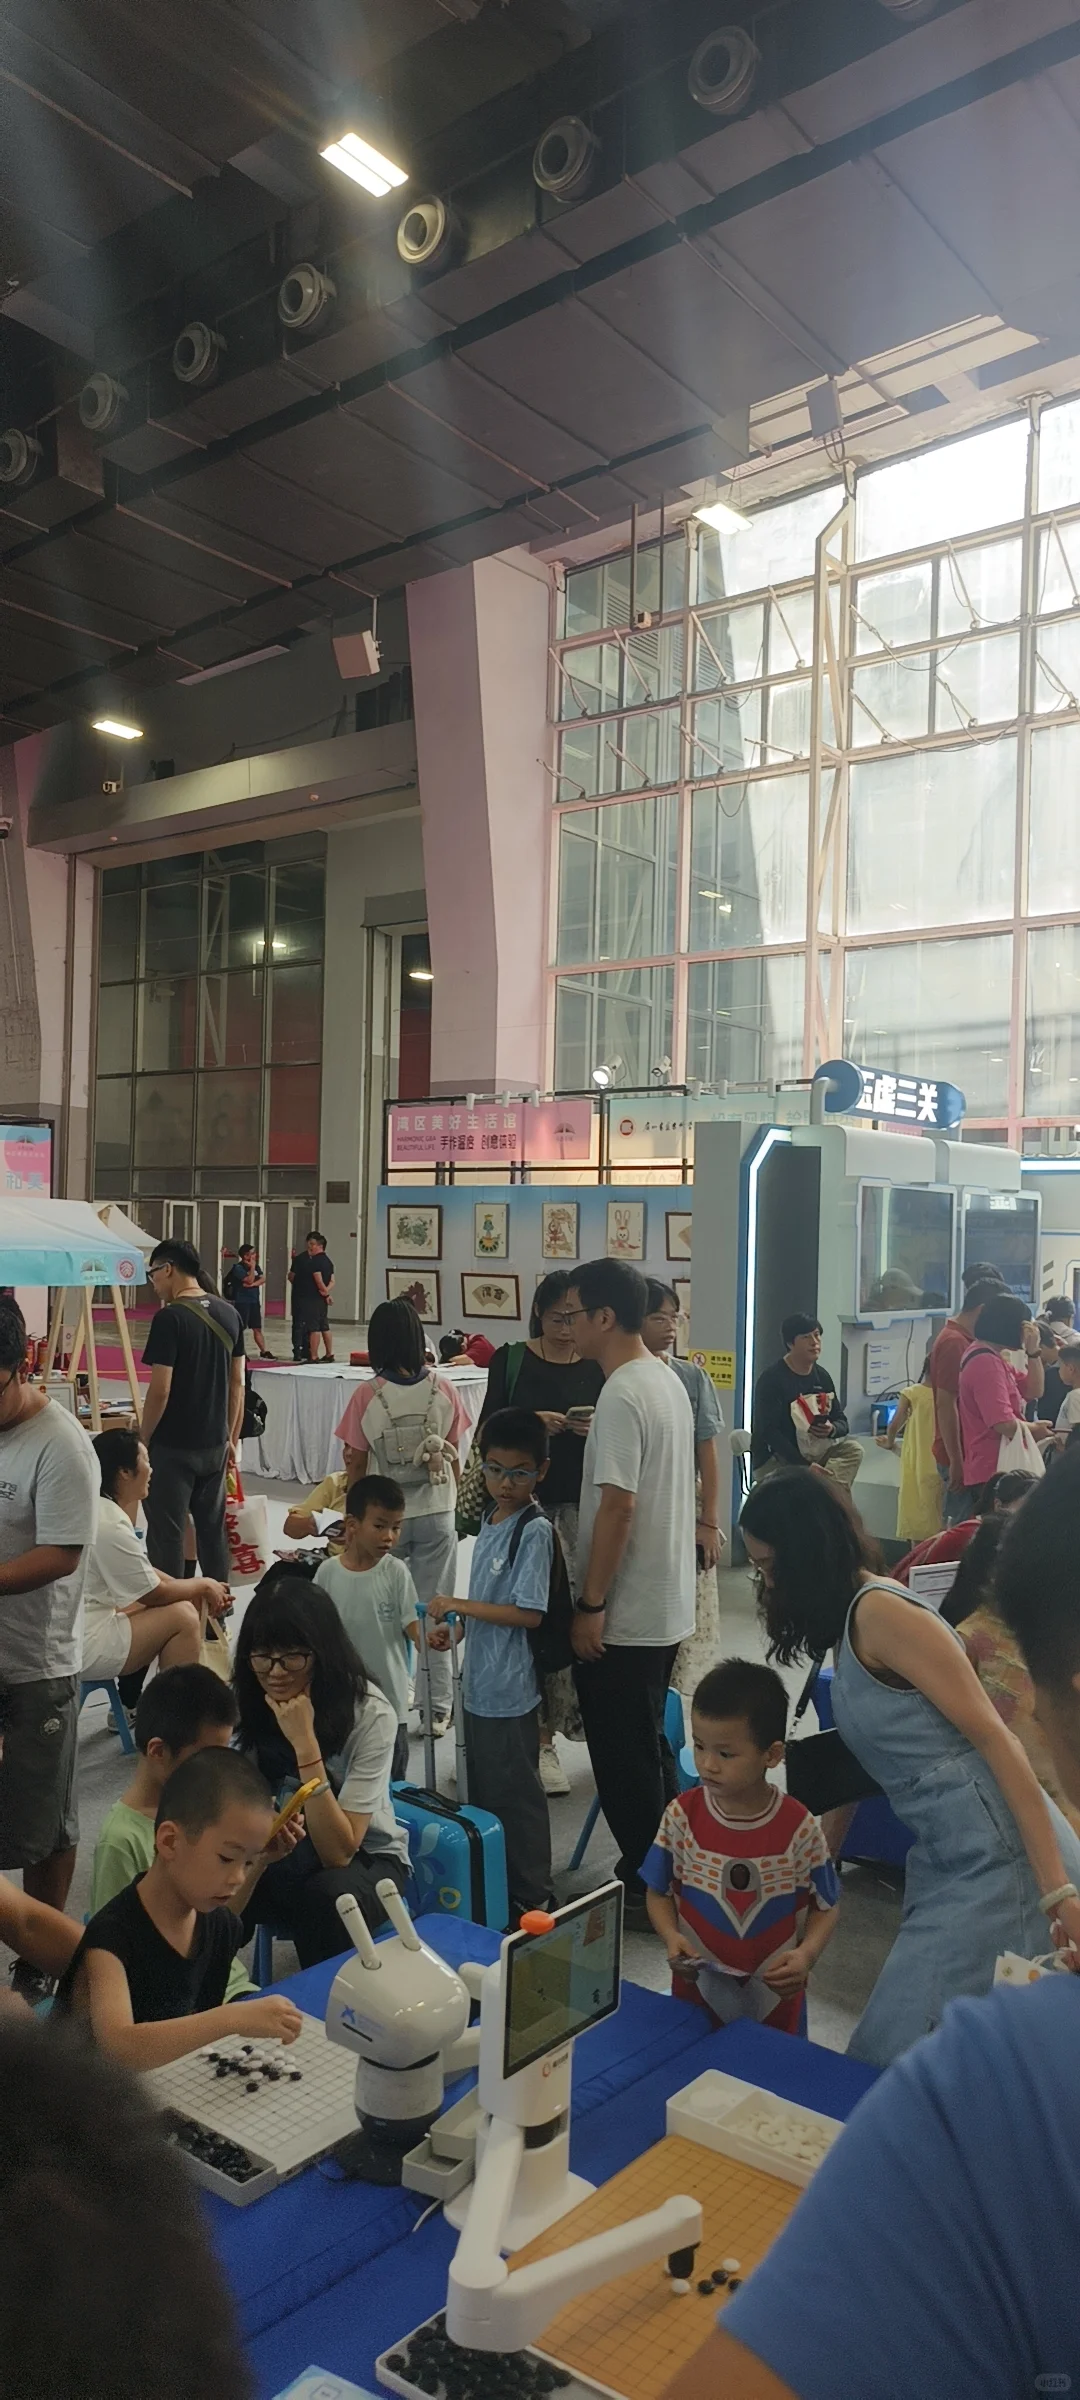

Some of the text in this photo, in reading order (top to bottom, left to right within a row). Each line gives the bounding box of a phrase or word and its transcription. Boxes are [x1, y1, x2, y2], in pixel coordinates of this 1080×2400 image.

[396, 1112, 518, 1132] 湾区美好生活馆
